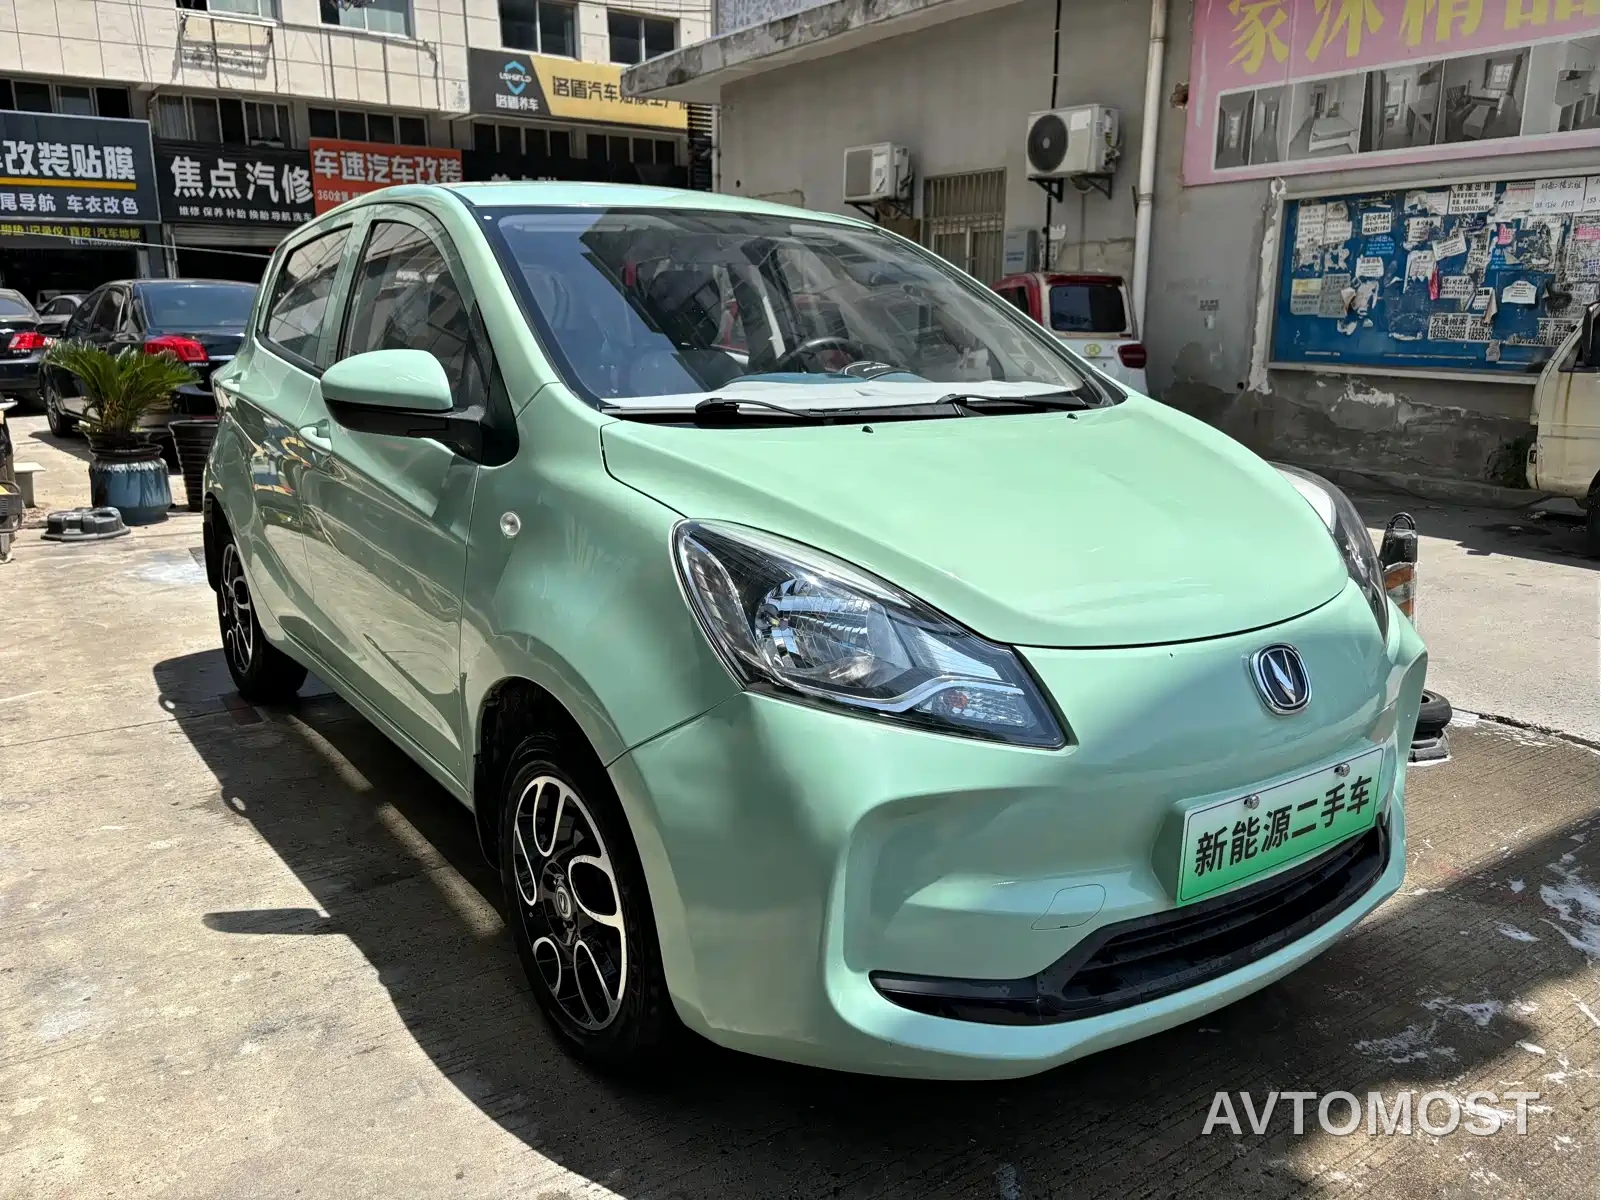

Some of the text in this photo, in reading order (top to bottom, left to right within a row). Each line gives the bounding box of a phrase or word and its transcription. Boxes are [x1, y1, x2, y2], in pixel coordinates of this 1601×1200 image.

[495, 93, 539, 111] 洛盾养车
[0, 139, 136, 180] 改装贴膜
[313, 148, 464, 184] 车速汽车改装
[170, 155, 314, 204] 焦点汽修
[0, 192, 139, 214] 尾导航 车衣改色
[179, 206, 200, 216] 维修
[203, 206, 223, 217] 保养
[226, 207, 247, 219] 补胎
[271, 211, 292, 222] 导航
[293, 211, 312, 222] 洗车
[1193, 775, 1373, 878] 新能源二手车
